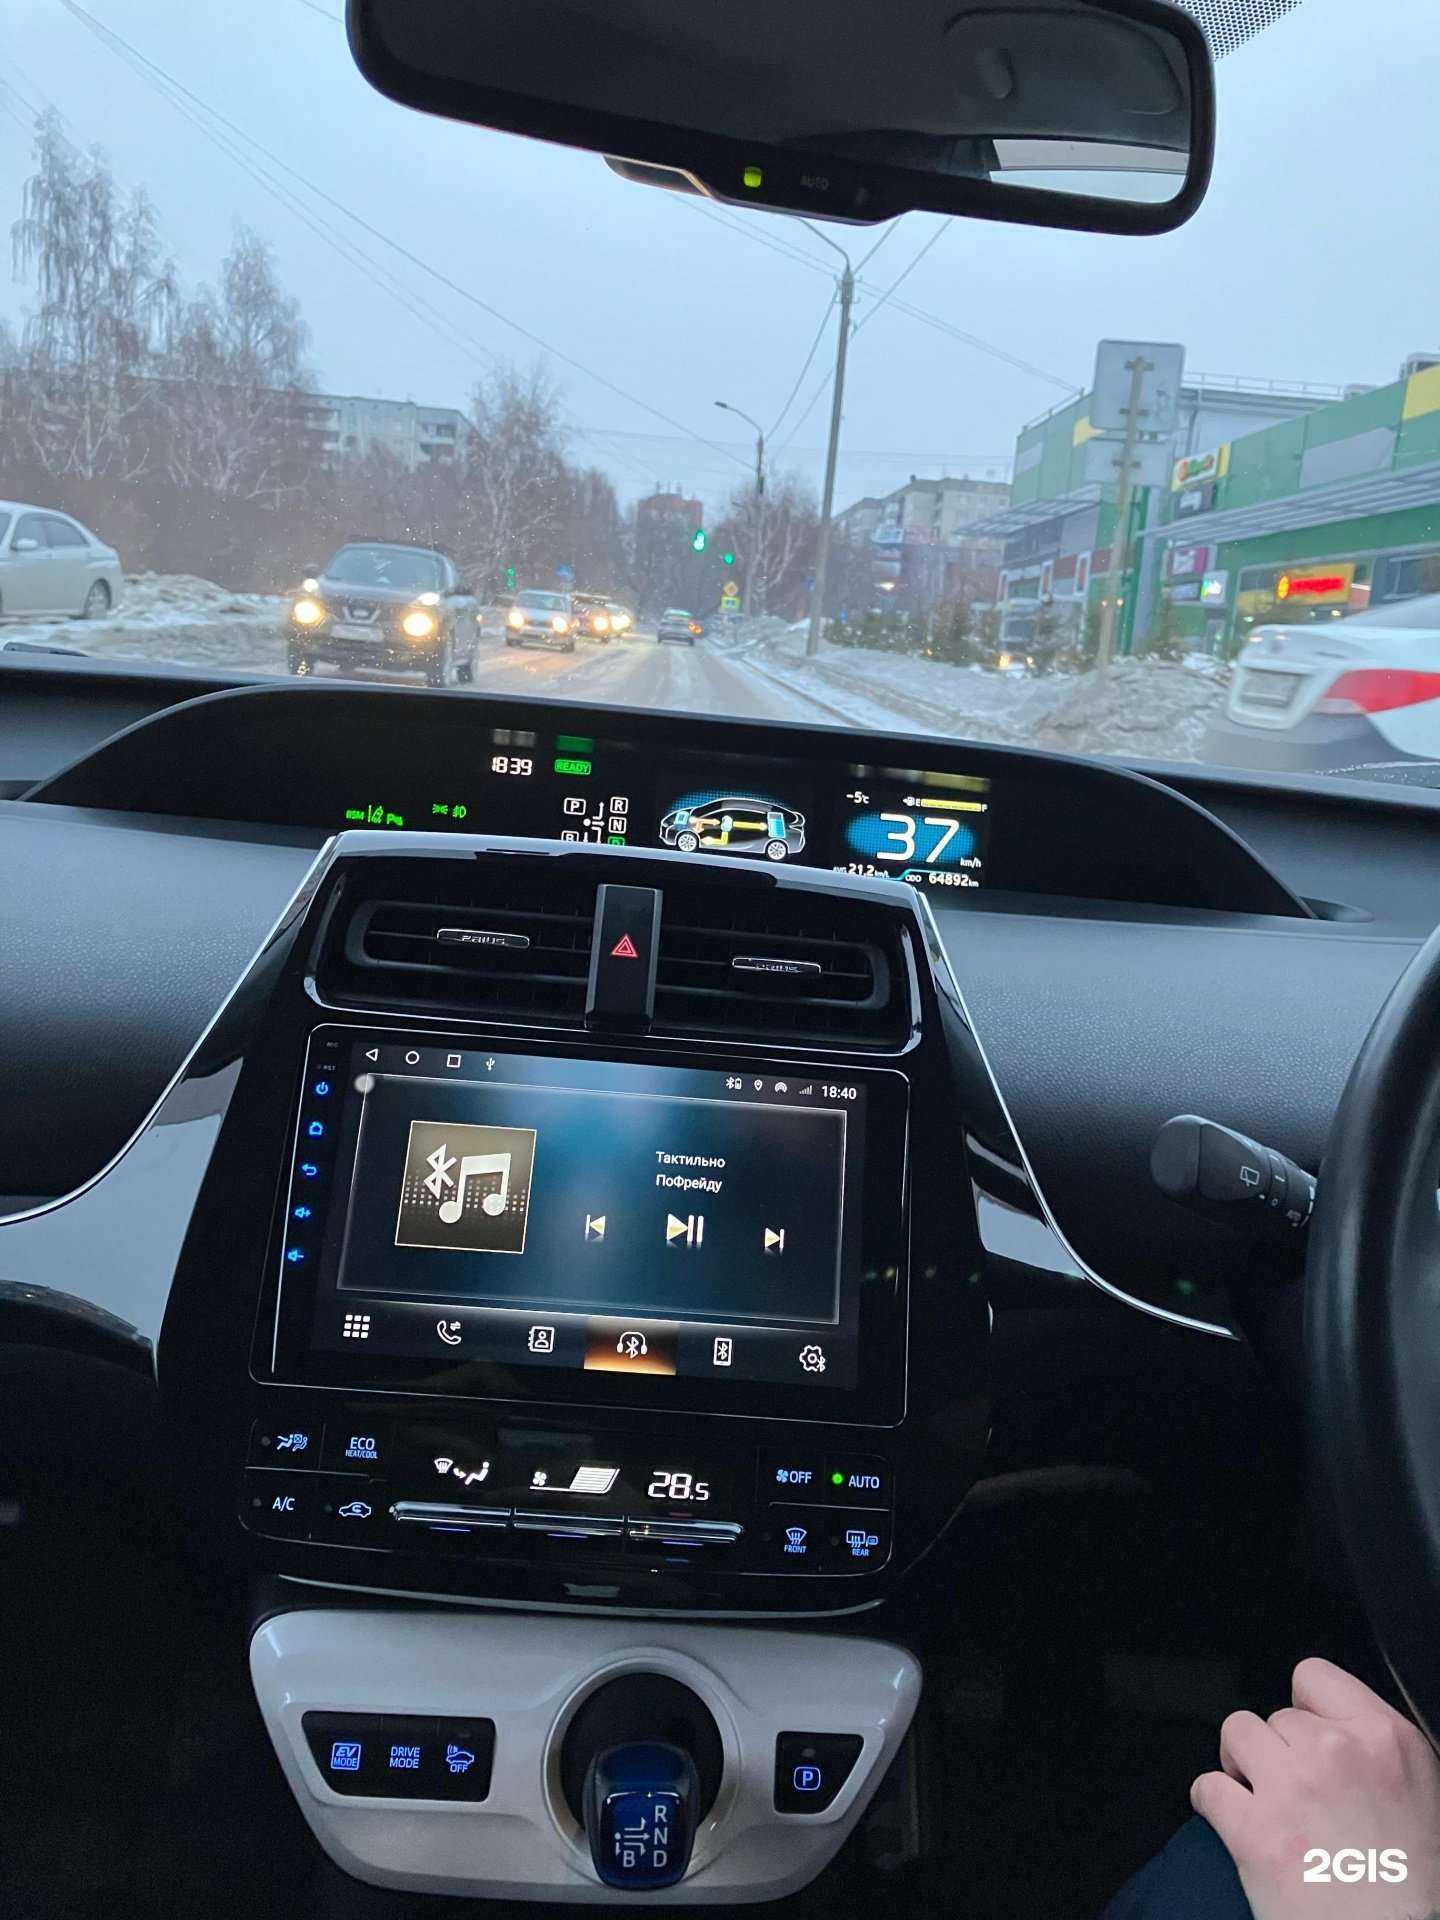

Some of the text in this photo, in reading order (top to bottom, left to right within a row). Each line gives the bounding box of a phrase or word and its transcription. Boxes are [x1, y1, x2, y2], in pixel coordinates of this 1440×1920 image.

[556, 761, 590, 773] READY
[570, 800, 580, 812] P
[614, 799, 624, 811] R
[613, 819, 623, 831] N
[876, 812, 960, 863] 37
[821, 1085, 857, 1100] 18:40
[655, 1150, 726, 1168] Тактильно
[350, 1436, 375, 1451] ECO
[345, 1449, 378, 1459] HEAT/COOL
[789, 1470, 812, 1484] OFF
[848, 1474, 880, 1489] AUTO
[647, 1471, 710, 1501] 28.5
[272, 1496, 295, 1511] A/C
[783, 1544, 807, 1554] FRONT
[851, 1548, 870, 1558] REAR
[335, 1746, 358, 1758] EV
[390, 1746, 421, 1757] DRIVE
[333, 1757, 357, 1767] MODE
[389, 1758, 419, 1769] MODE
[449, 1763, 468, 1773] OFF
[802, 1770, 814, 1787] P
[654, 1805, 668, 1823] R
[653, 1827, 668, 1846] N
[622, 1850, 635, 1868] B
[653, 1850, 667, 1868] D
